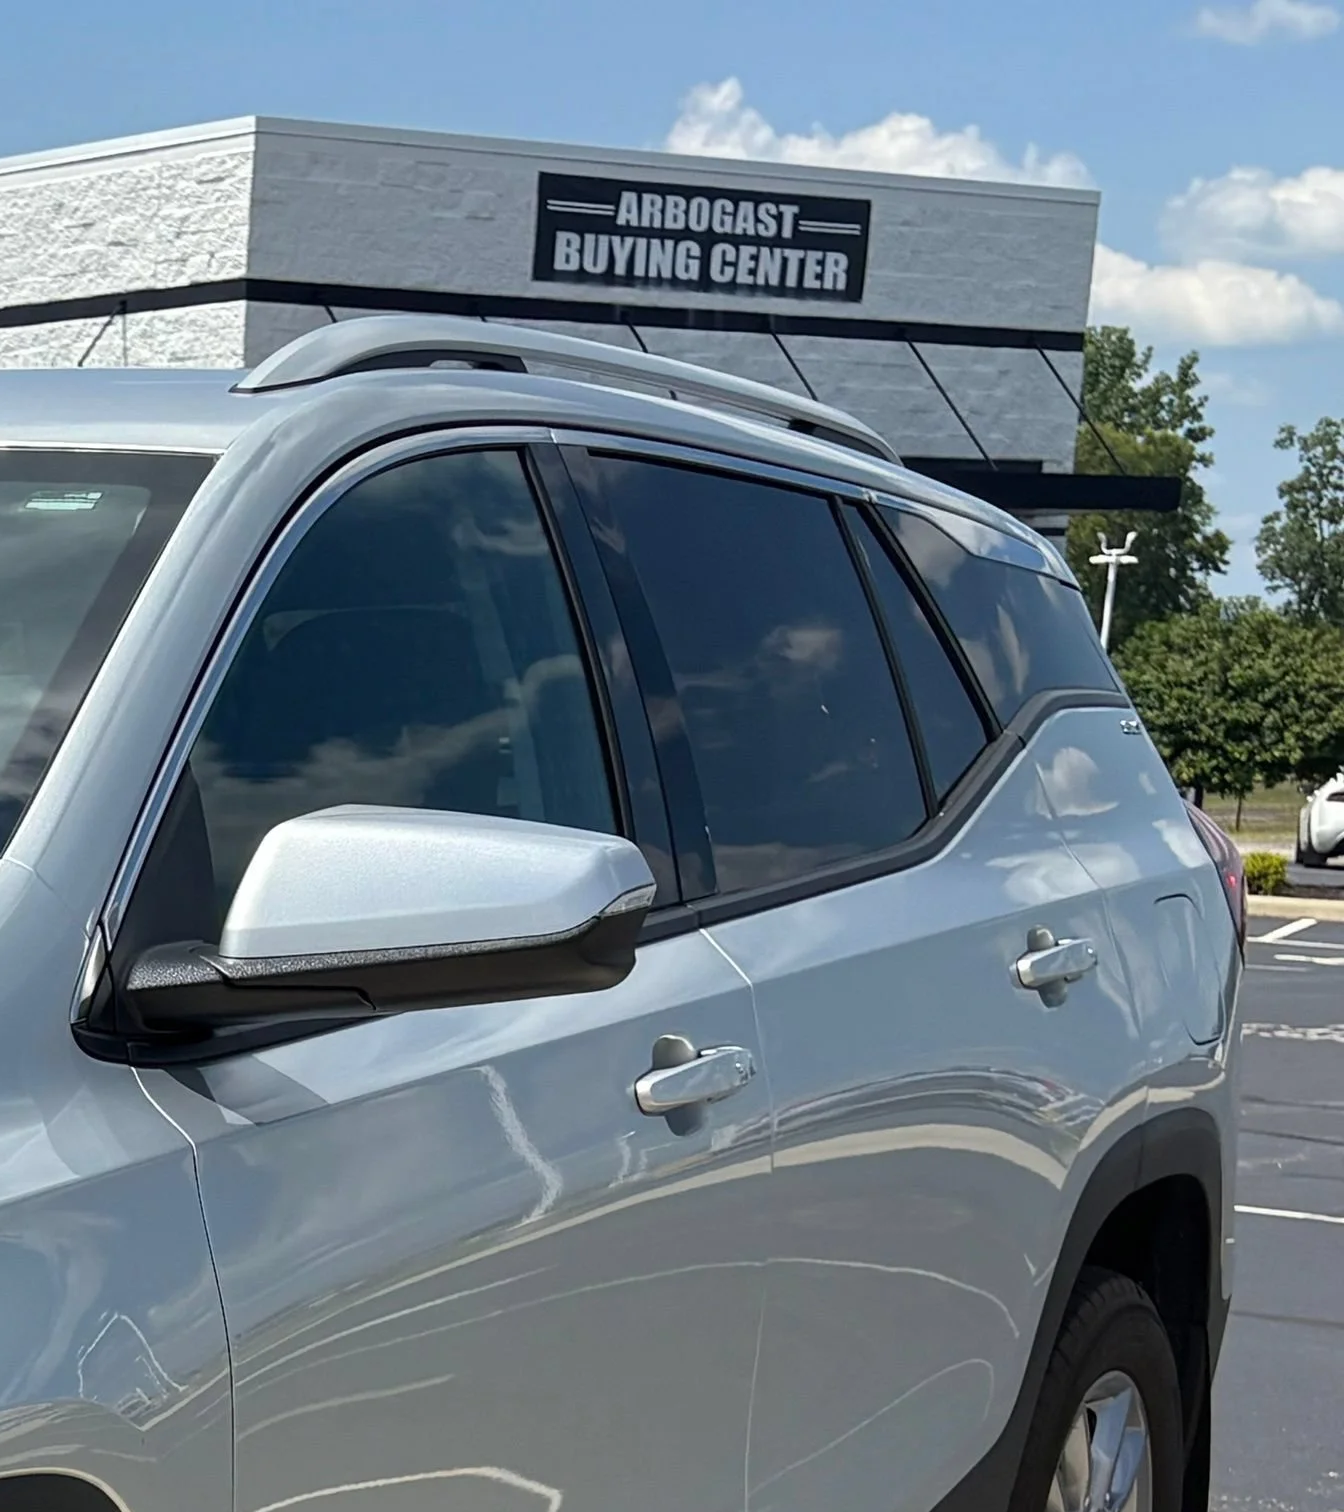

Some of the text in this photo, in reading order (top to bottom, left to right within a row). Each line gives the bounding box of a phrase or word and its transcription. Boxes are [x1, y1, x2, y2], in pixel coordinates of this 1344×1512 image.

[616, 190, 799, 238] ARBOGAST
[553, 231, 849, 291] BUYING CENTER
